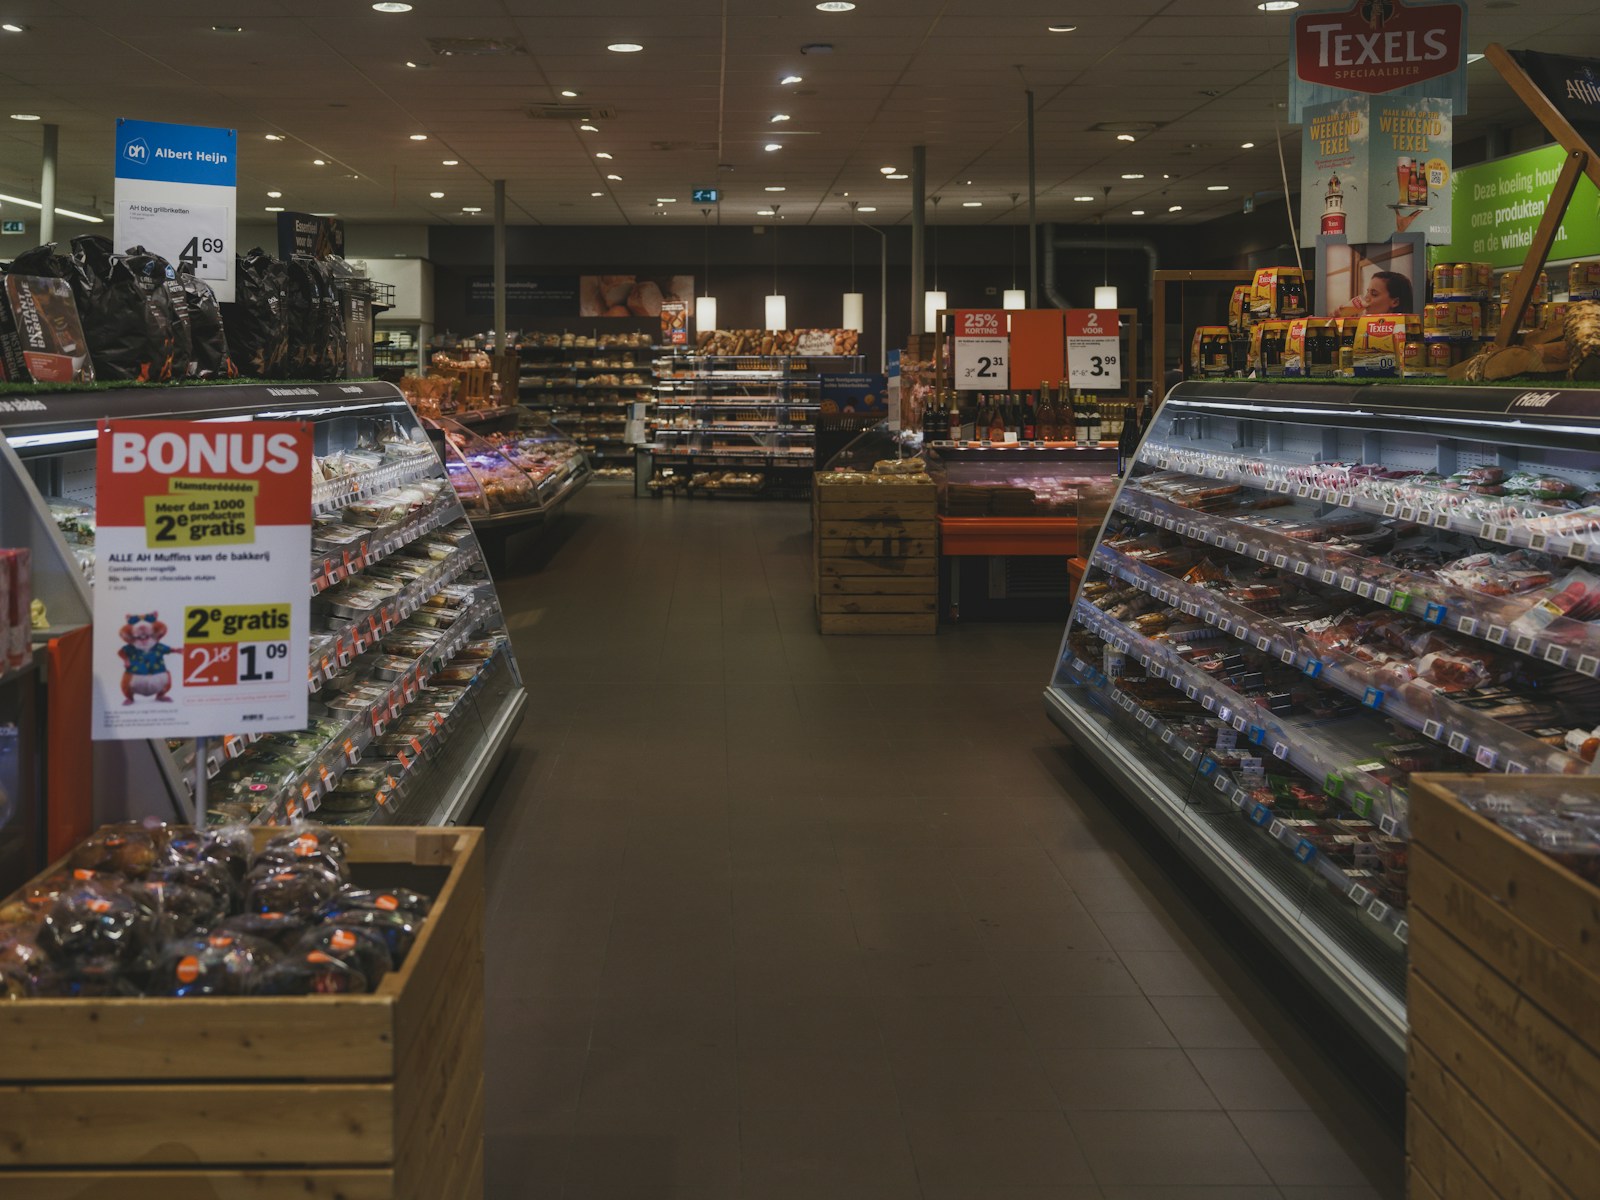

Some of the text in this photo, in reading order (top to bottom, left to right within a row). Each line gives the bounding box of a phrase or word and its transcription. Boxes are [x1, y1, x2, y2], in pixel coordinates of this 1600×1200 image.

[1306, 23, 1448, 67] TEXELS
[1335, 66, 1420, 80] SPECIAALBIER
[1310, 119, 1360, 141] WEEKEND
[1380, 116, 1442, 136] WEEKEND
[1320, 136, 1350, 156] TEXEL
[1392, 134, 1429, 152] TEXEL
[155, 147, 228, 164] Albert Heijn
[1474, 162, 1564, 201] Deze koeling houd
[1471, 211, 1493, 228] onze
[1495, 200, 1545, 228] produkten
[1474, 241, 1484, 254] en
[1487, 234, 1498, 252] de
[1501, 226, 1532, 250] winkel
[18, 292, 38, 348] INSTANT
[21, 281, 46, 348] BARBECUE
[964, 314, 998, 327] 25%
[1088, 313, 1098, 326] 2
[1368, 323, 1393, 333] TEXELS
[0, 334, 20, 380] BARBECUE
[8, 332, 26, 368] INSTANT
[977, 357, 1003, 377] 2.31
[1090, 356, 1116, 376] 3.99
[1515, 392, 1560, 407] Halal
[112, 432, 299, 474] BONUS
[156, 499, 245, 513] Meer dan 1000
[190, 511, 245, 521] producten
[190, 520, 246, 540] gratis
[109, 554, 133, 562] ALLE
[136, 554, 151, 562] AH
[154, 553, 191, 562] Muffins
[216, 552, 228, 561] de
[231, 551, 270, 563] bakkerij
[187, 608, 289, 638] 2e gratis
[240, 644, 287, 681] 1.09
